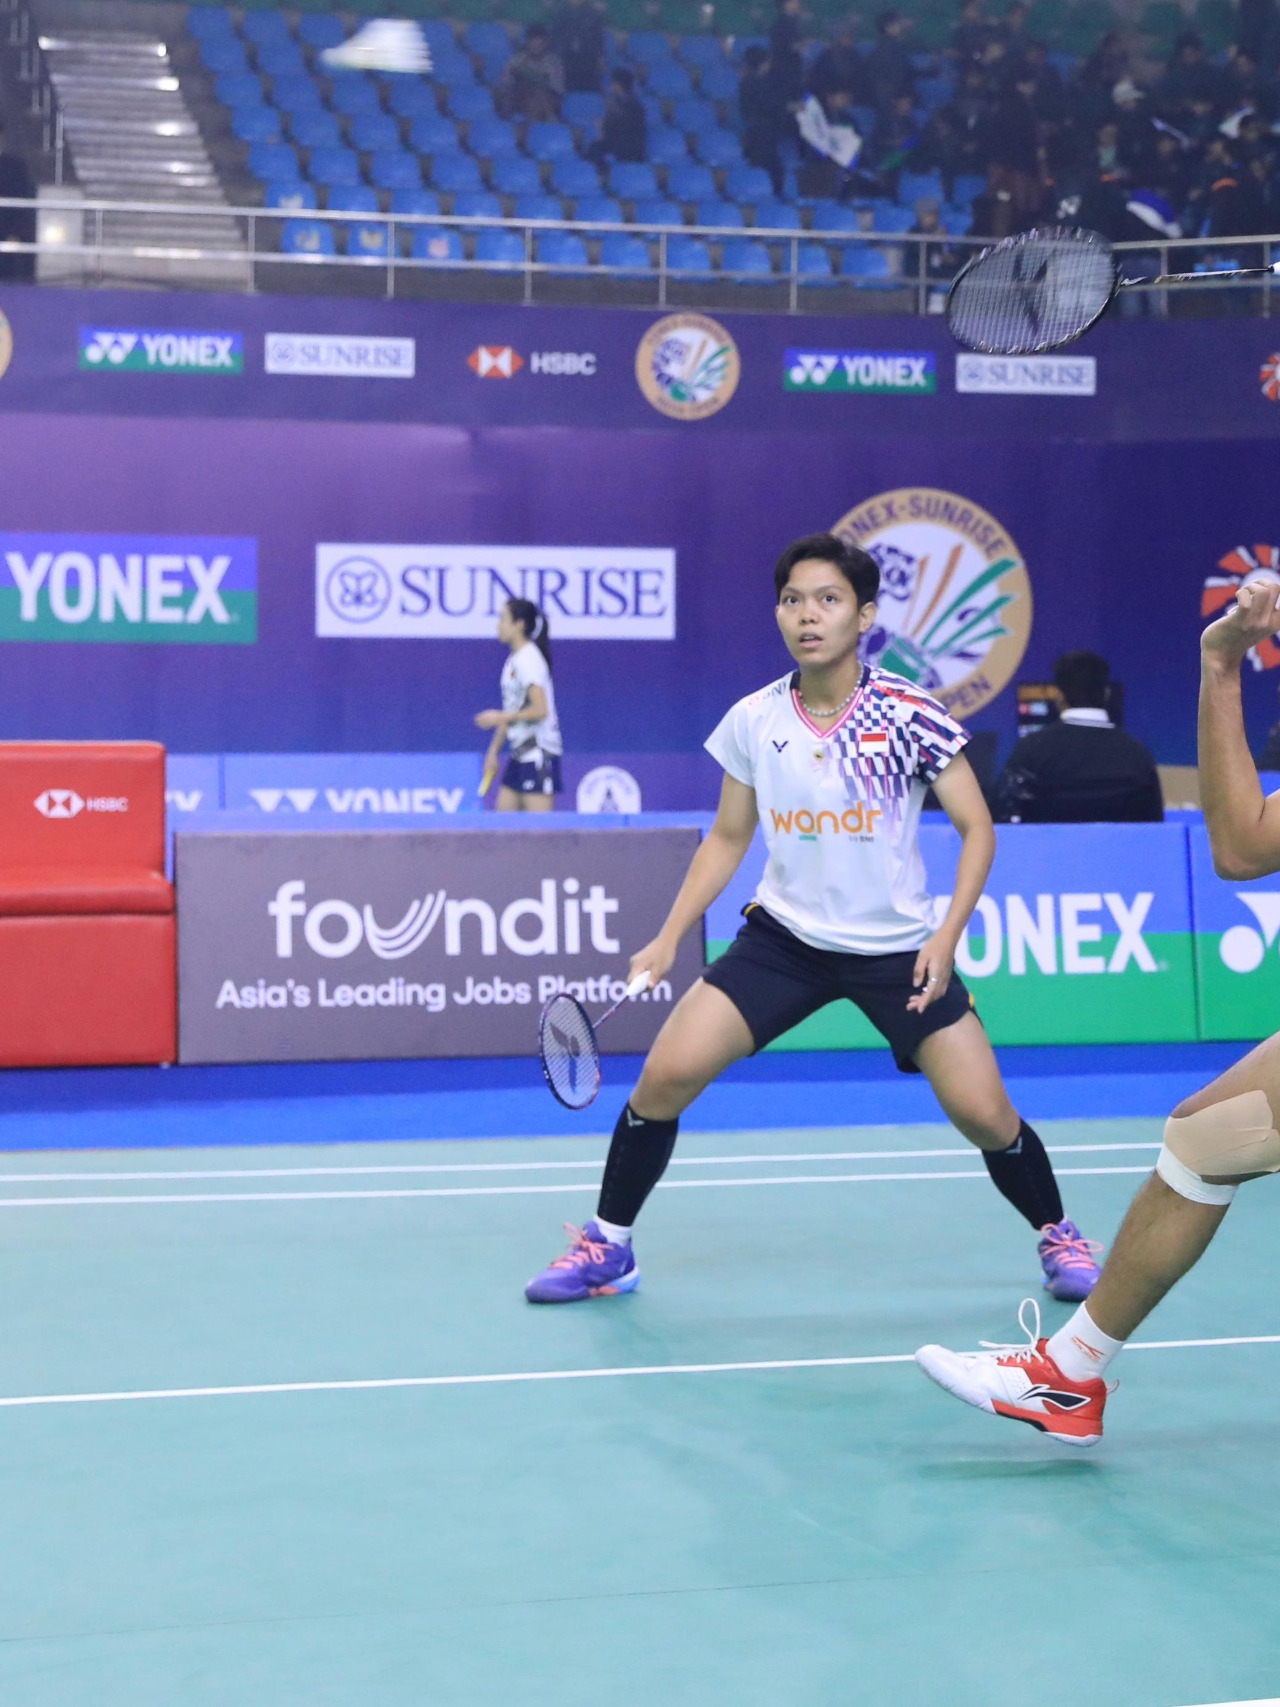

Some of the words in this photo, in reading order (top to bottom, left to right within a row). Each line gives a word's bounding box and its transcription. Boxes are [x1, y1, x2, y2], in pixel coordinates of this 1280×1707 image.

[143, 335, 233, 367] YONEX
[300, 341, 411, 369] SUNRISE
[531, 351, 596, 375] HSBC
[842, 356, 927, 387] YONEX
[988, 361, 1093, 386] SUNRISE
[6, 552, 232, 624] YONEX
[400, 565, 667, 618] SUNRISE
[88, 797, 127, 811] HSBC
[268, 880, 620, 960] foundit
[934, 892, 1158, 977] ONEX
[216, 978, 310, 1009] Asia's
[318, 977, 446, 1012] Leading
[453, 976, 532, 1006] Jobs
